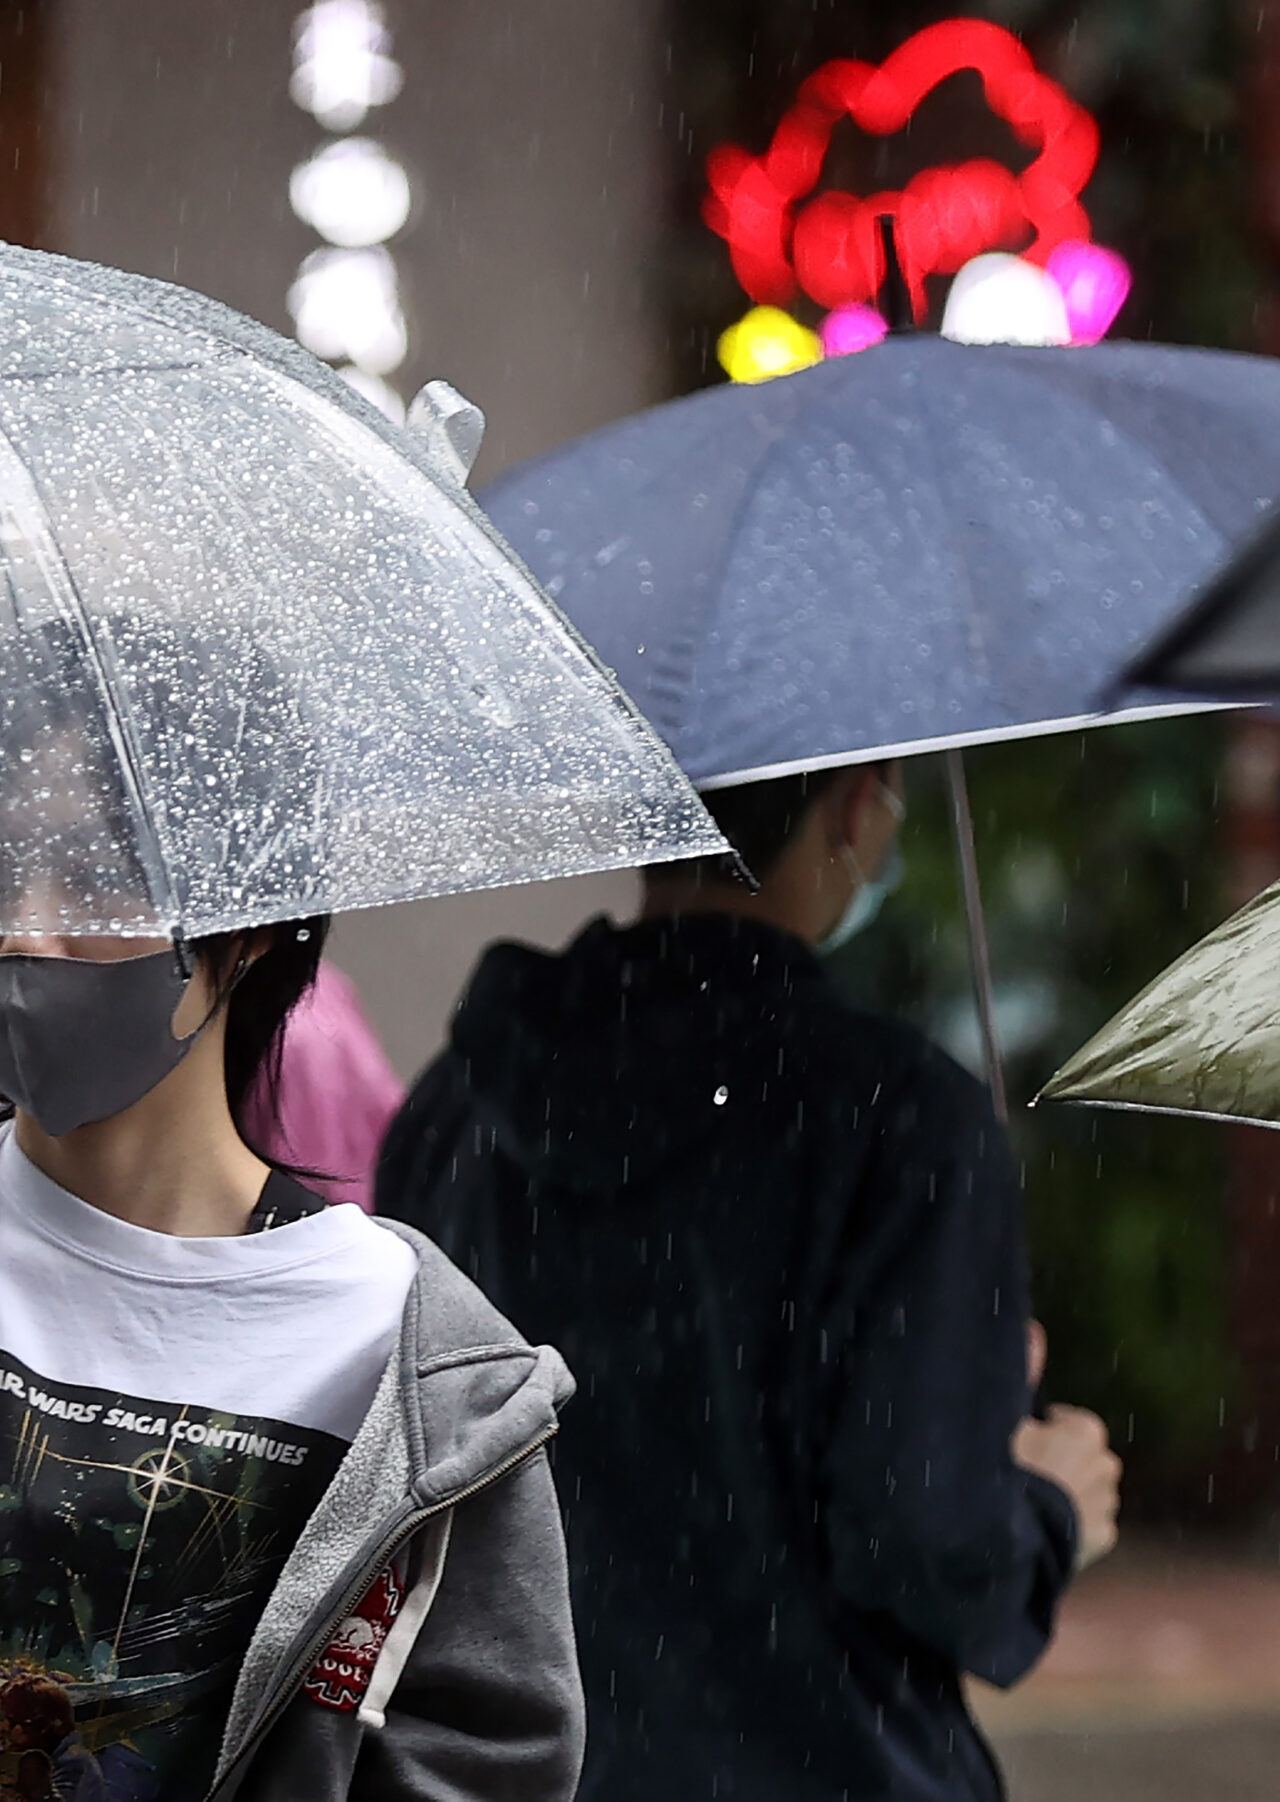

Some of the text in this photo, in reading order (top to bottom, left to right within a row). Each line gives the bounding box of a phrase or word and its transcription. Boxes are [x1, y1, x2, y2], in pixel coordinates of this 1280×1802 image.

[28, 1386, 103, 1423] WARS
[102, 1408, 167, 1436] SAGA
[170, 1420, 309, 1466] CONTINUES
